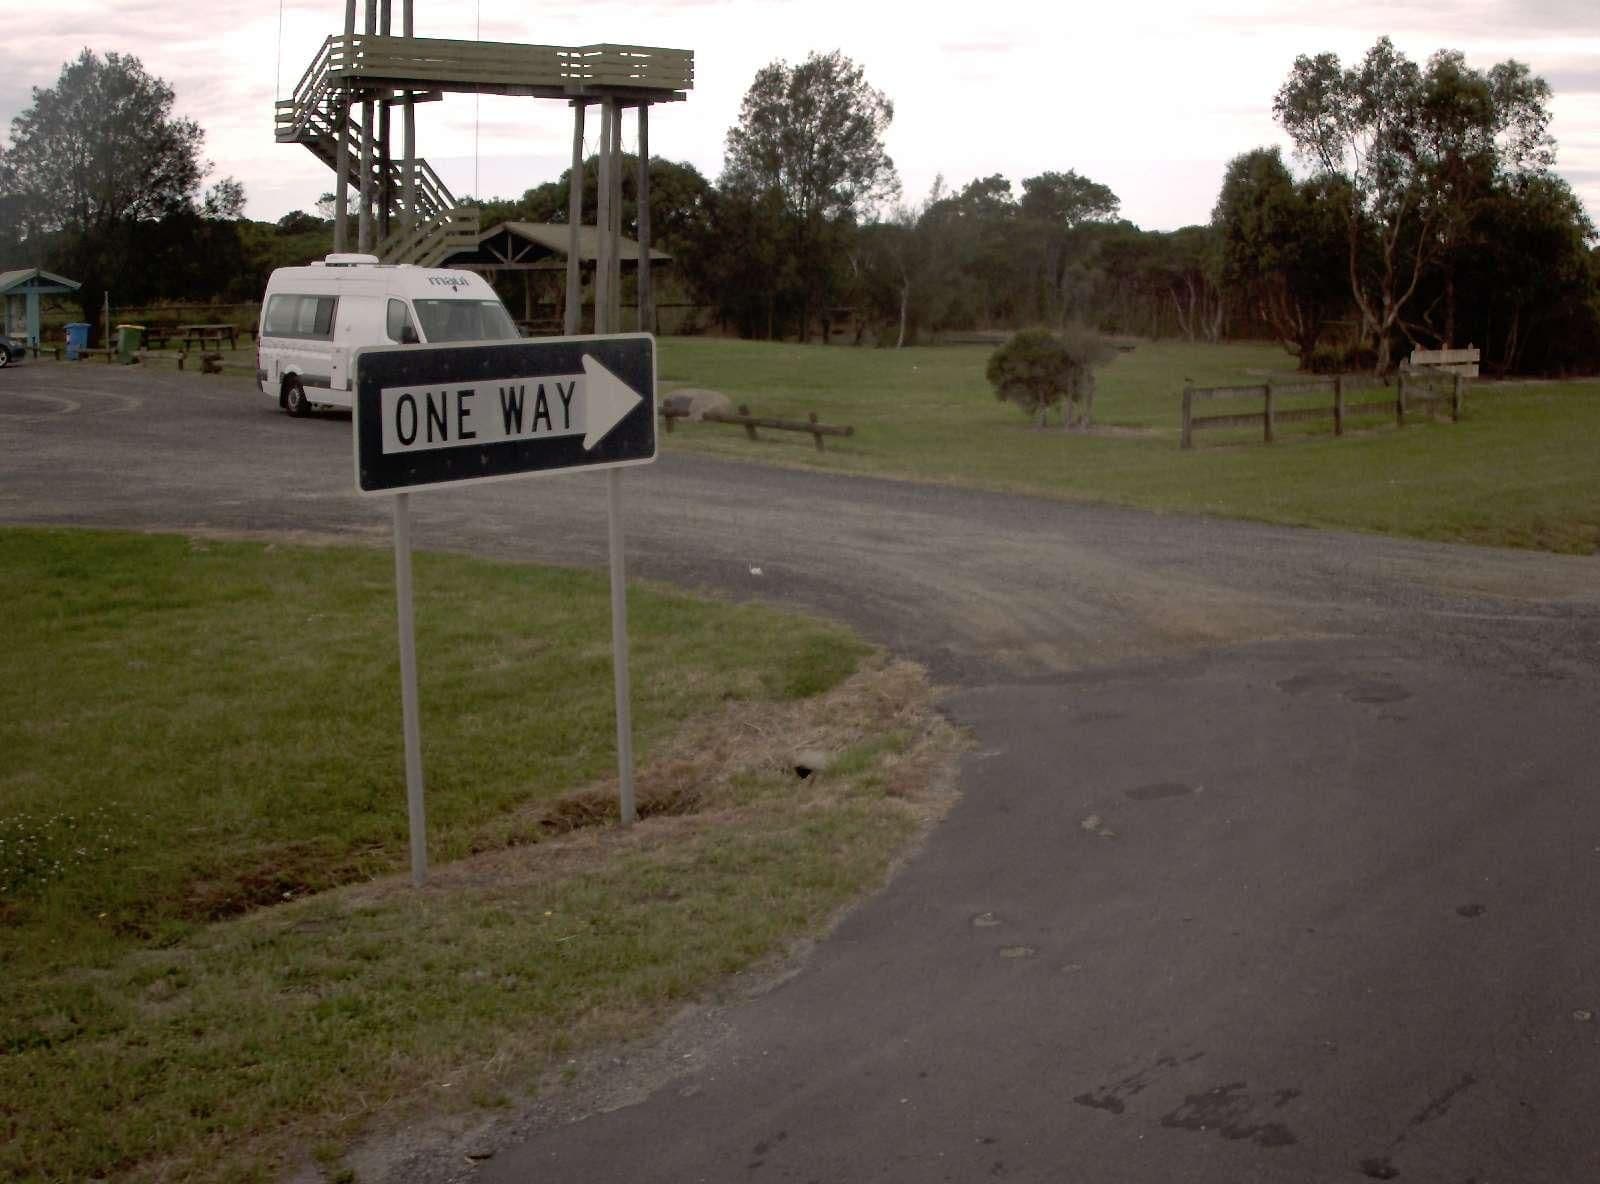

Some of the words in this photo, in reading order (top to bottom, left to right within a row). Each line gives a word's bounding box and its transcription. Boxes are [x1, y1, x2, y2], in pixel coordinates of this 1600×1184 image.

[428, 276, 469, 286] maui
[395, 390, 476, 446] ONE
[499, 381, 576, 435] WAY
